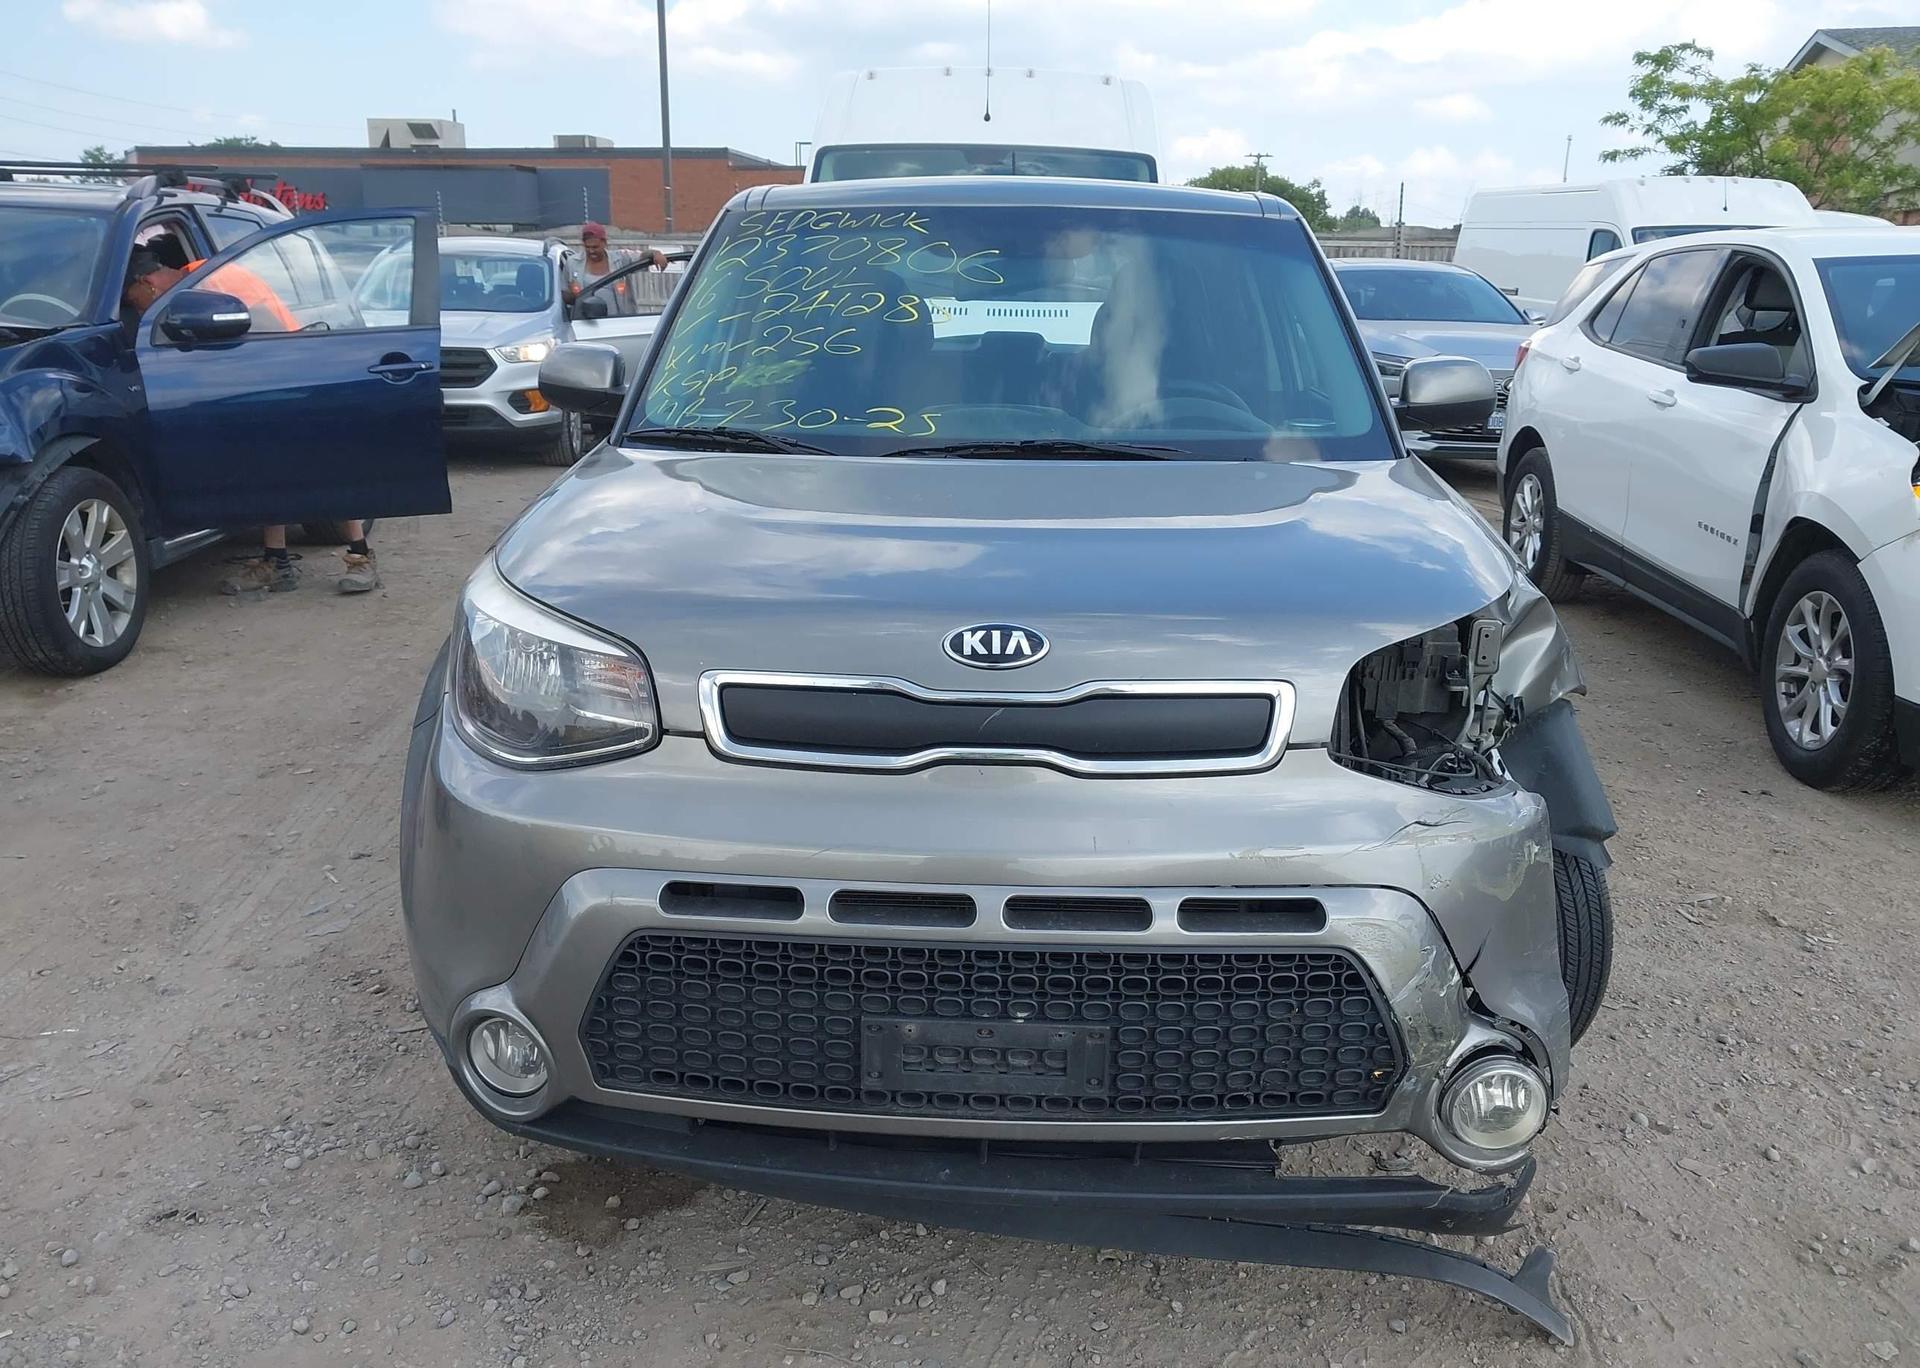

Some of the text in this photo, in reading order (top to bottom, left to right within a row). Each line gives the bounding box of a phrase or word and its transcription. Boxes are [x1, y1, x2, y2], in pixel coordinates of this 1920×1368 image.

[737, 210, 930, 237] SEDGWICK
[735, 264, 876, 300] SOUL
[962, 630, 1033, 656] KIA
